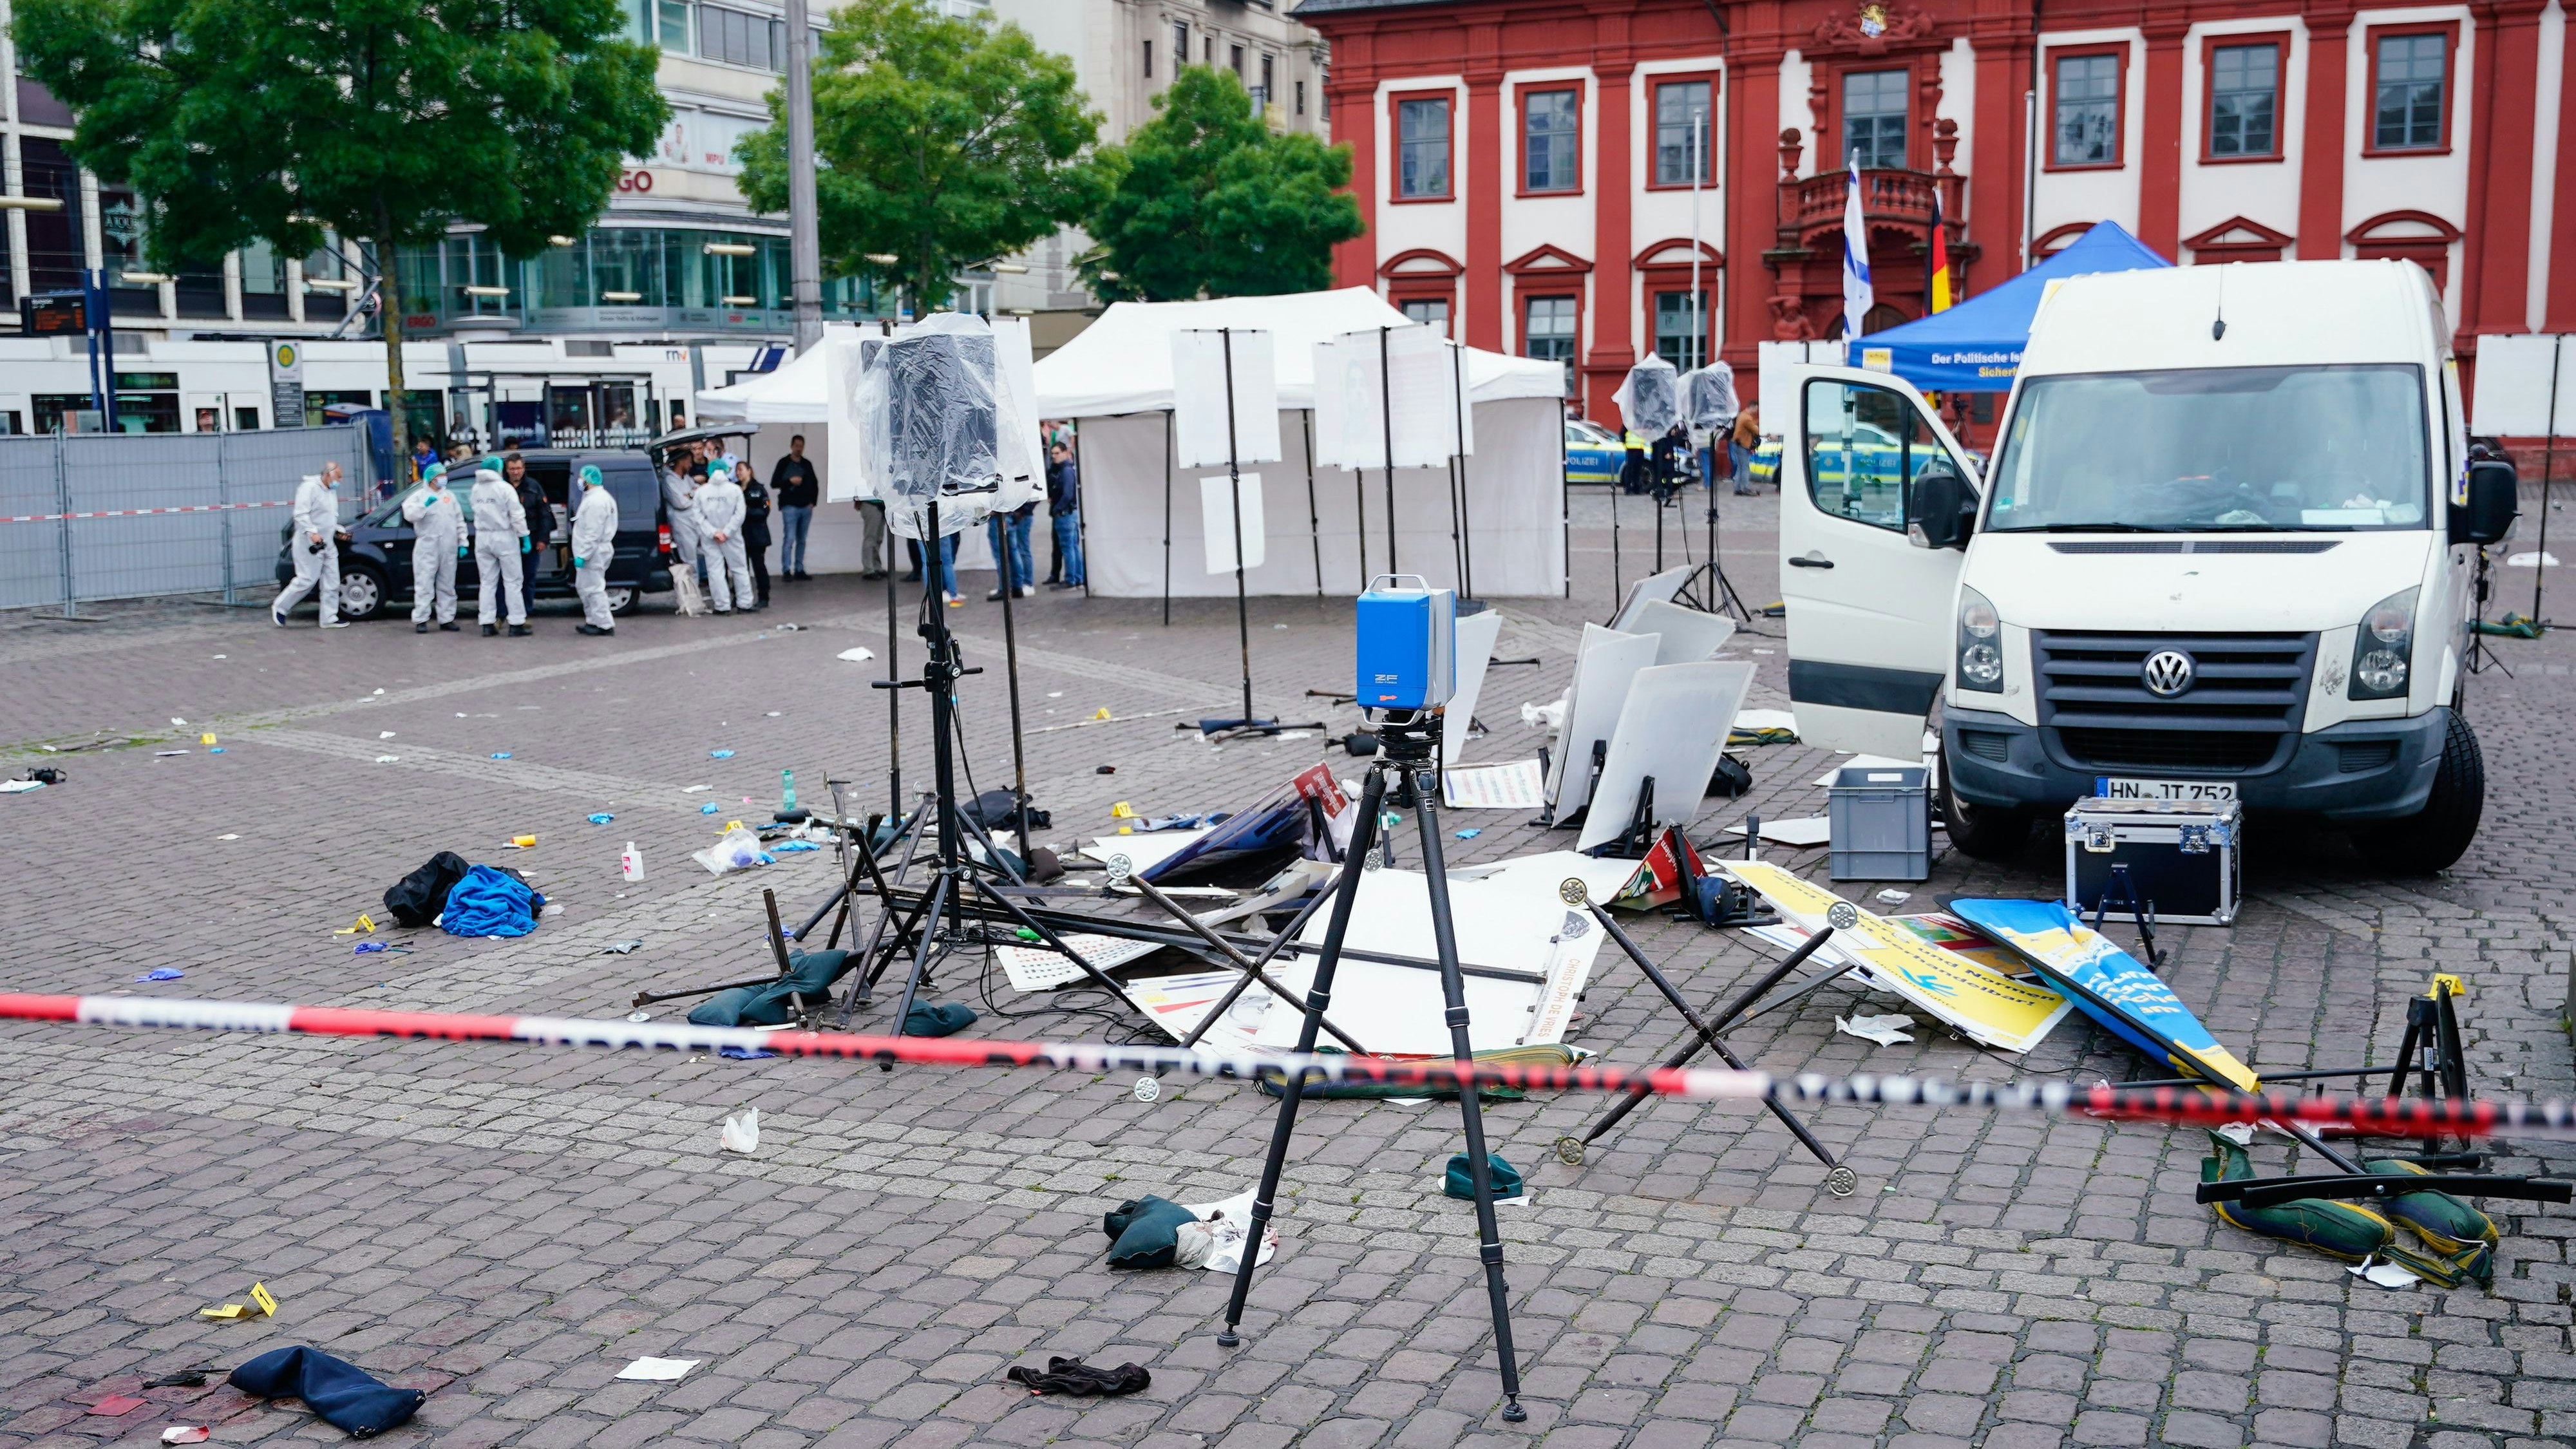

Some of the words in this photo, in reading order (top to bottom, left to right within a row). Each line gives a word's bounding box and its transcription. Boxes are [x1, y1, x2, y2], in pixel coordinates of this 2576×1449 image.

[616, 171, 652, 192] GO
[1932, 352, 1951, 365] Der
[1954, 351, 2007, 364] Politische
[2110, 781, 2139, 798] HN
[2190, 785, 2231, 800] 752
[1119, 804, 1128, 815] 17
[1880, 935, 2036, 1006] verhandelbar!
[1918, 947, 1959, 968] und
[1965, 969, 2057, 1002] Normen
[1553, 958, 1580, 1005] CHRISTOPH
[1548, 1005, 1563, 1016] DE
[1537, 1016, 1558, 1038] VRIES
